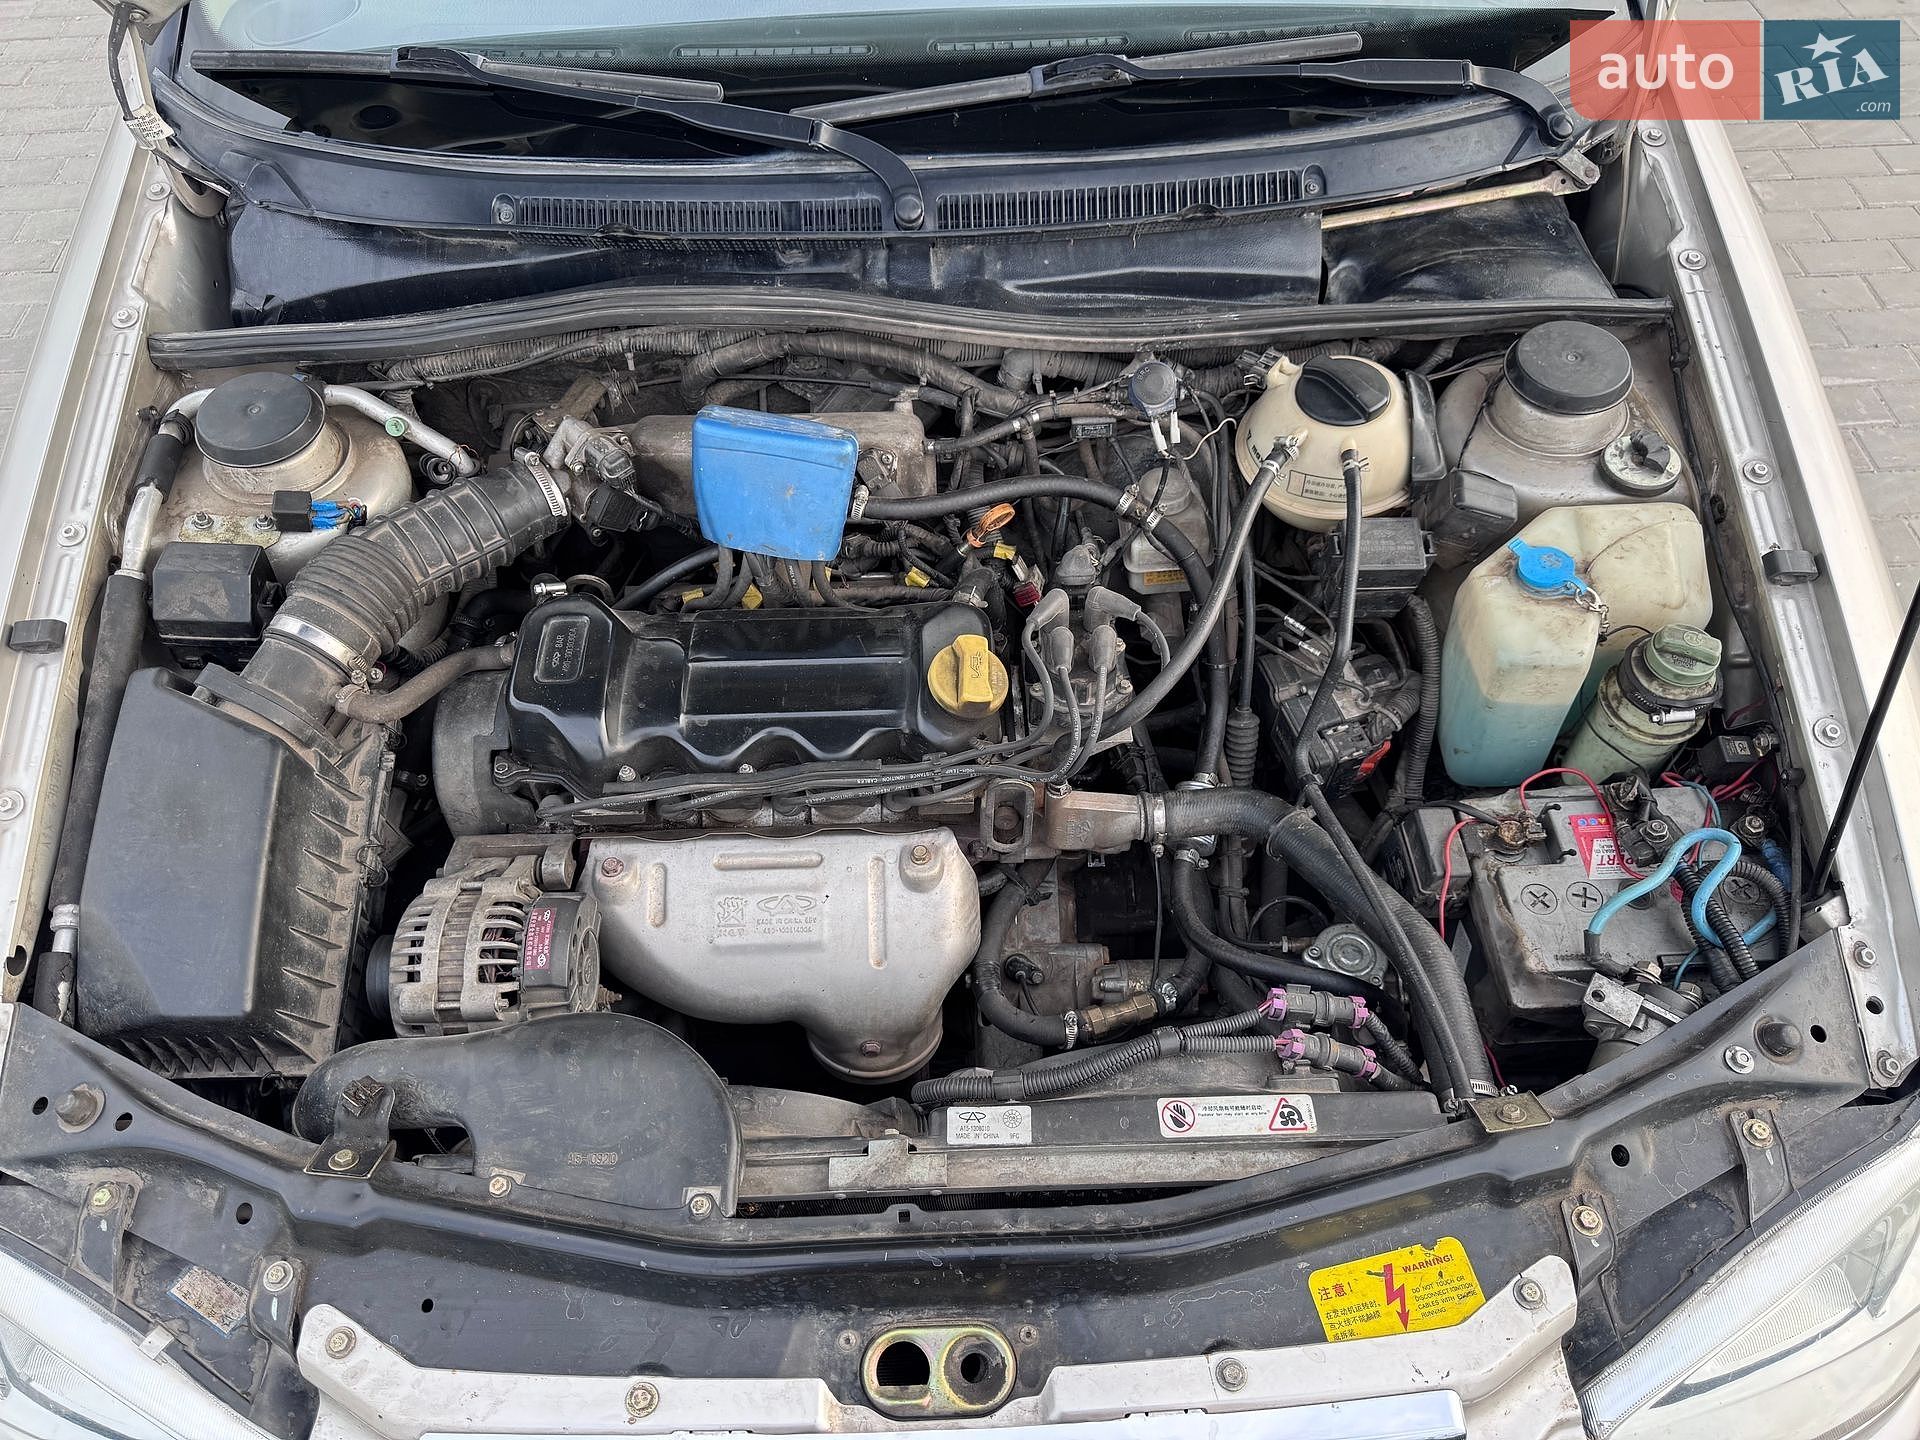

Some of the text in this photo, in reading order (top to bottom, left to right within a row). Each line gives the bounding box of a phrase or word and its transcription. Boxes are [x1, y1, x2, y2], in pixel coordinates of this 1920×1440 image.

[1402, 1254, 1454, 1273] WARNING!
[1422, 1283, 1434, 1291] NOT
[1436, 1279, 1455, 1287] TOUCH
[1415, 1282, 1474, 1302] DISCONNECT IGNITION
[1418, 1300, 1440, 1310] CABLES
[1421, 1307, 1447, 1318] RUNNING
